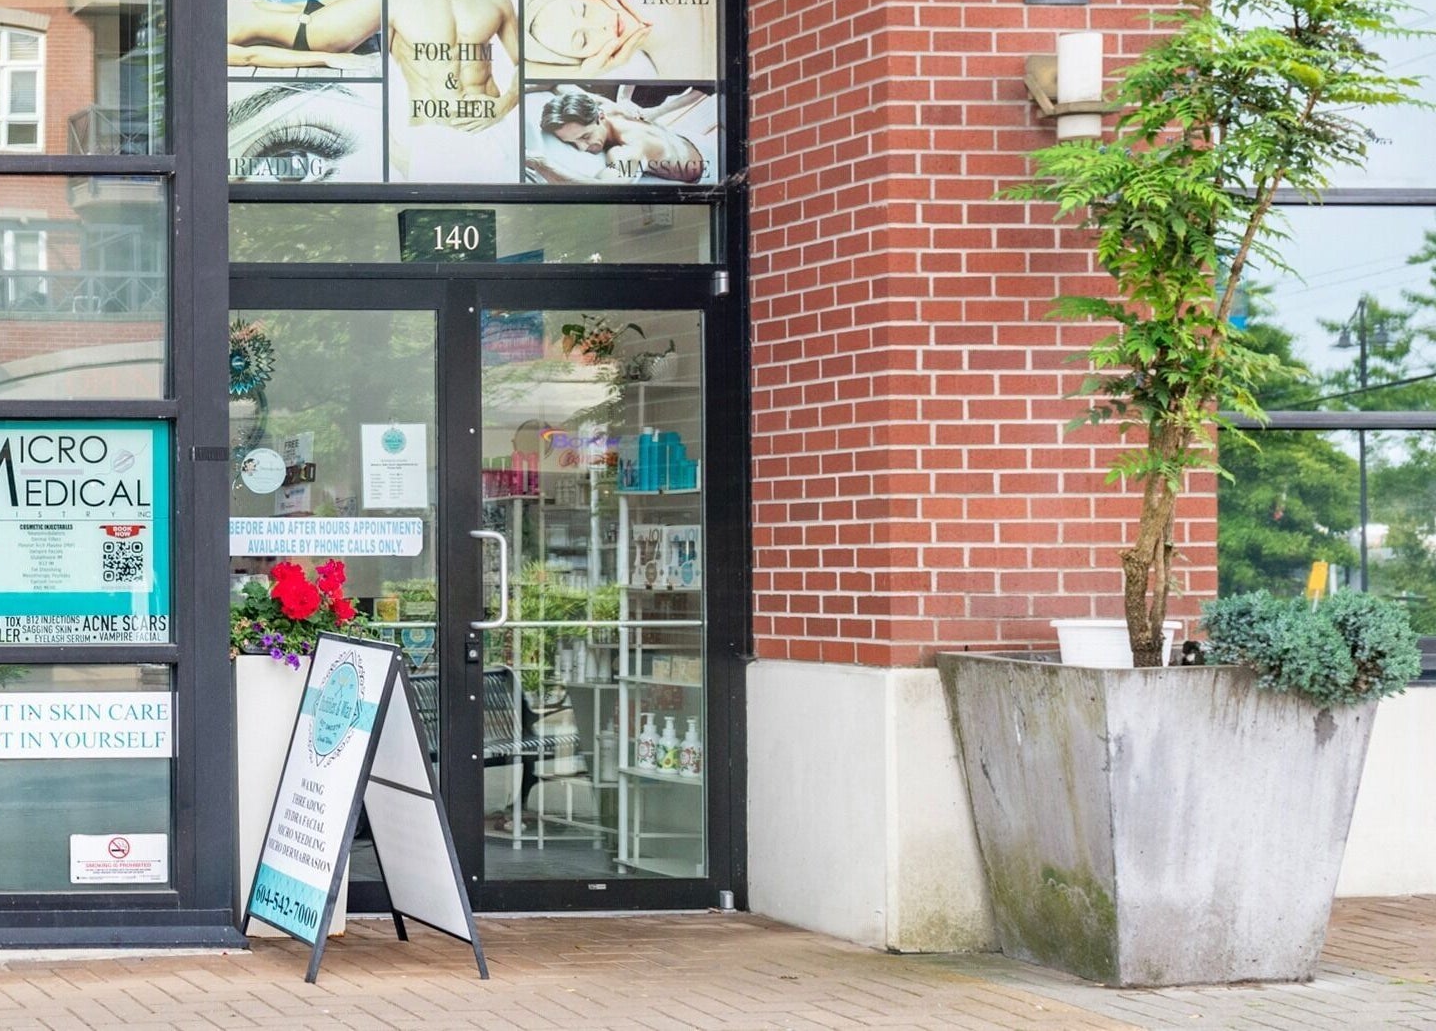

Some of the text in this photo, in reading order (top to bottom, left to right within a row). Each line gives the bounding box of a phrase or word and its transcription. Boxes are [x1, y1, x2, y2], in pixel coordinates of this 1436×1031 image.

[413, 42, 494, 62] FOR HIM
[444, 72, 459, 91] &
[411, 100, 497, 120] FOR HER
[228, 157, 323, 177] READING
[432, 225, 480, 252] 140
[230, 521, 422, 535] BEFORE AND AFTER HOURS APPOINTMENTS
[248, 539, 297, 554] AVAILABLE
[299, 539, 311, 554] BY
[314, 539, 344, 554] PHONE
[347, 539, 376, 554] CALLS
[5, 617, 22, 628] TOX
[26, 616, 40, 625] B12
[41, 615, 81, 625] INJECTIONS
[82, 616, 118, 632] ACNE
[122, 615, 167, 632] SCARS
[22, 625, 73, 634] SAGGING SKIN
[34, 632, 162, 643] EYELASH SERUM VAMPIRE FACIAL
[20, 704, 42, 722] IN
[49, 703, 102, 722] SKIN
[108, 702, 170, 722] CARE
[20, 732, 43, 750] IN
[49, 731, 168, 750] YOURSELF
[300, 777, 325, 796] WAXING
[291, 793, 327, 815] THREADING
[256, 882, 319, 930] 604-542-7000
